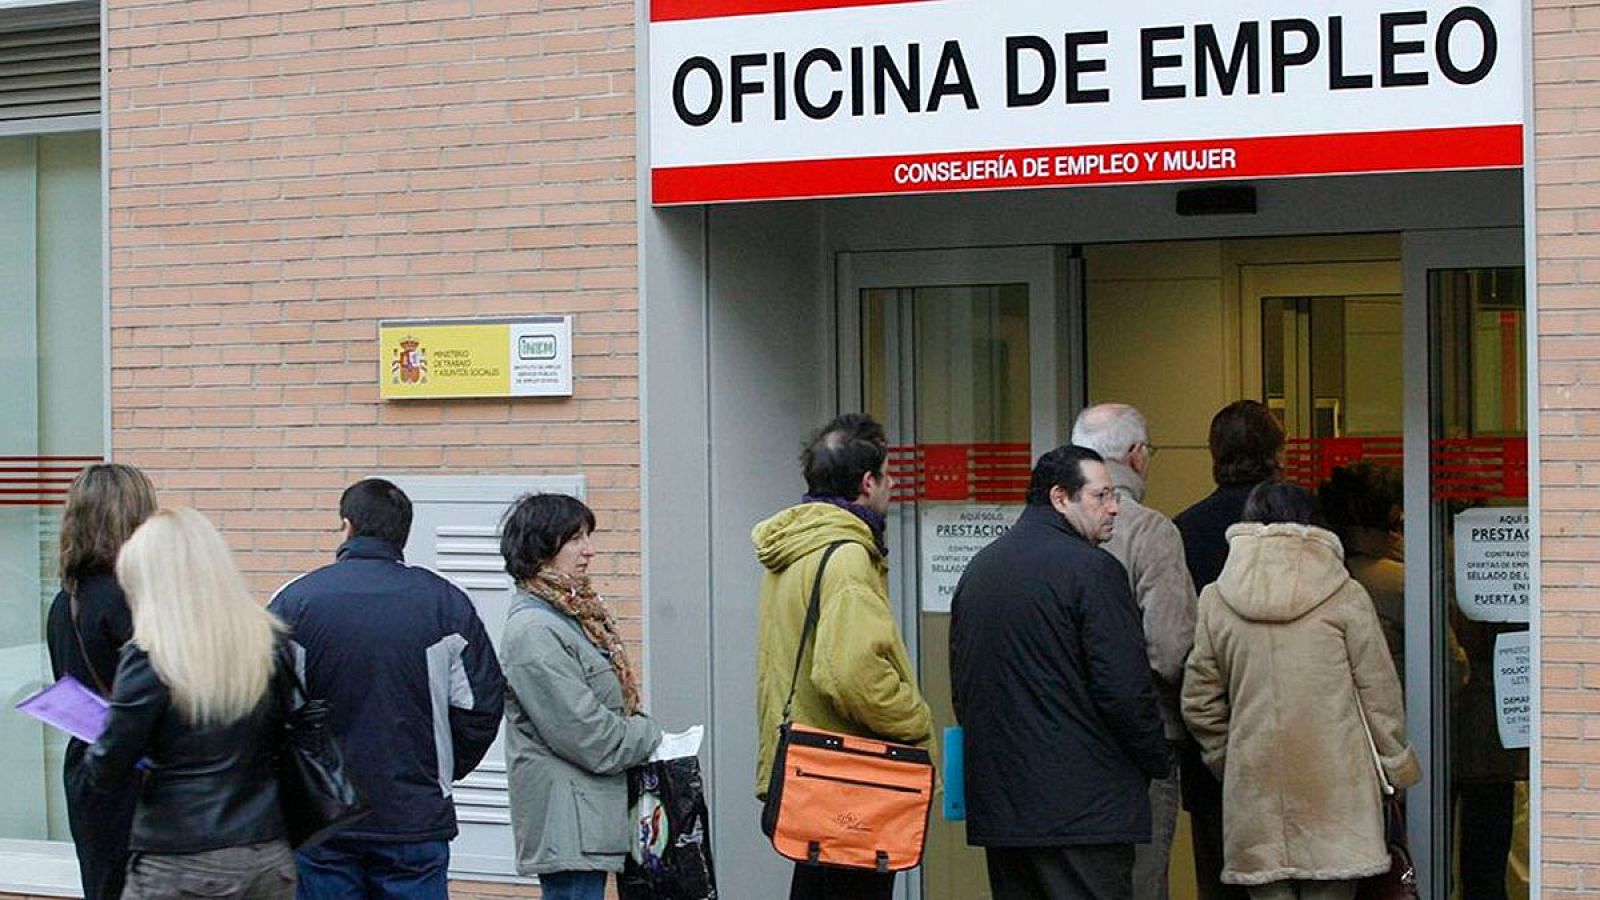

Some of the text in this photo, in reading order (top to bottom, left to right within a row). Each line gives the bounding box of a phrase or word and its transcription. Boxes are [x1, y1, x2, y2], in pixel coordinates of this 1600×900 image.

[673, 6, 1498, 127] OFICINA DE EMPLEO
[894, 148, 1236, 184] CONSEJERÍA DE EMPLEO Y MUJER
[1467, 571, 1508, 581] SELLADO
[1509, 571, 1521, 581] DE
[1474, 594, 1517, 605] PUERTA
